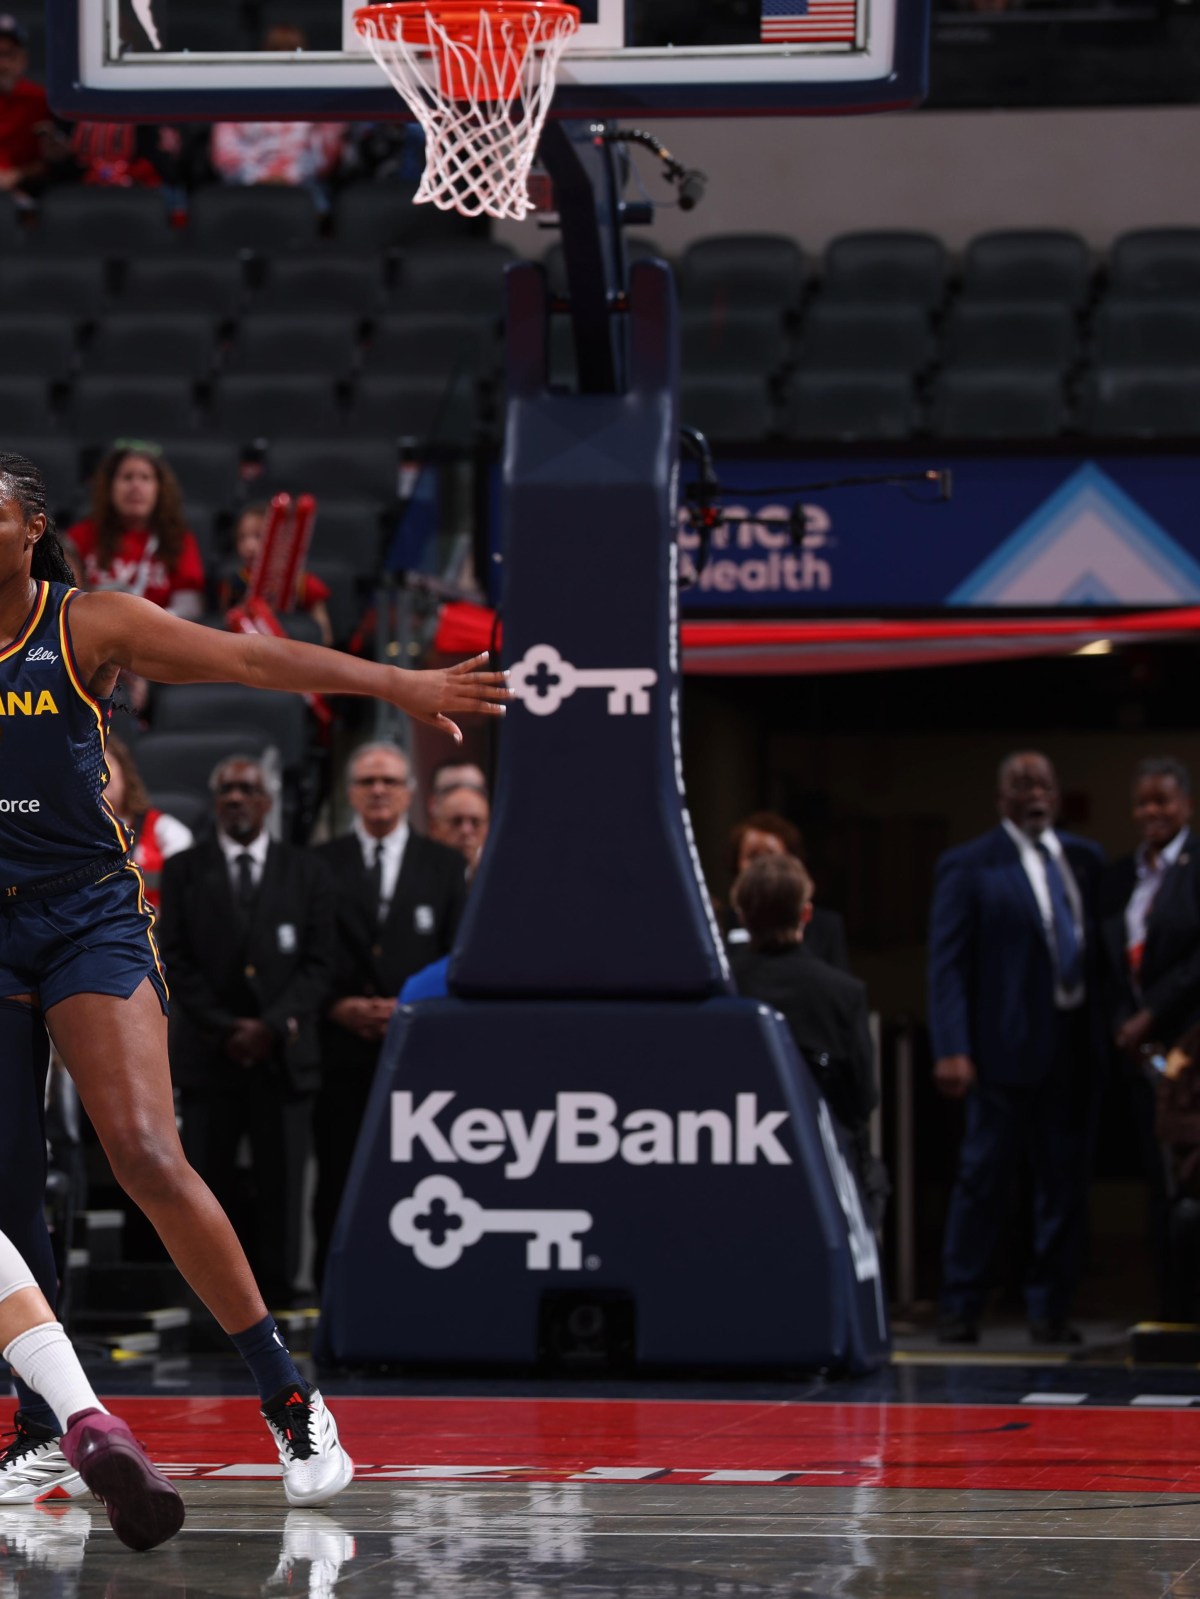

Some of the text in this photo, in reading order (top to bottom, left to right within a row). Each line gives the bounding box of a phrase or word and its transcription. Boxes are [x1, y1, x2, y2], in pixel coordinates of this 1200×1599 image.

[677, 503, 831, 549] nce
[25, 646, 59, 664] Lilly
[391, 1091, 793, 1180] KeyBank
